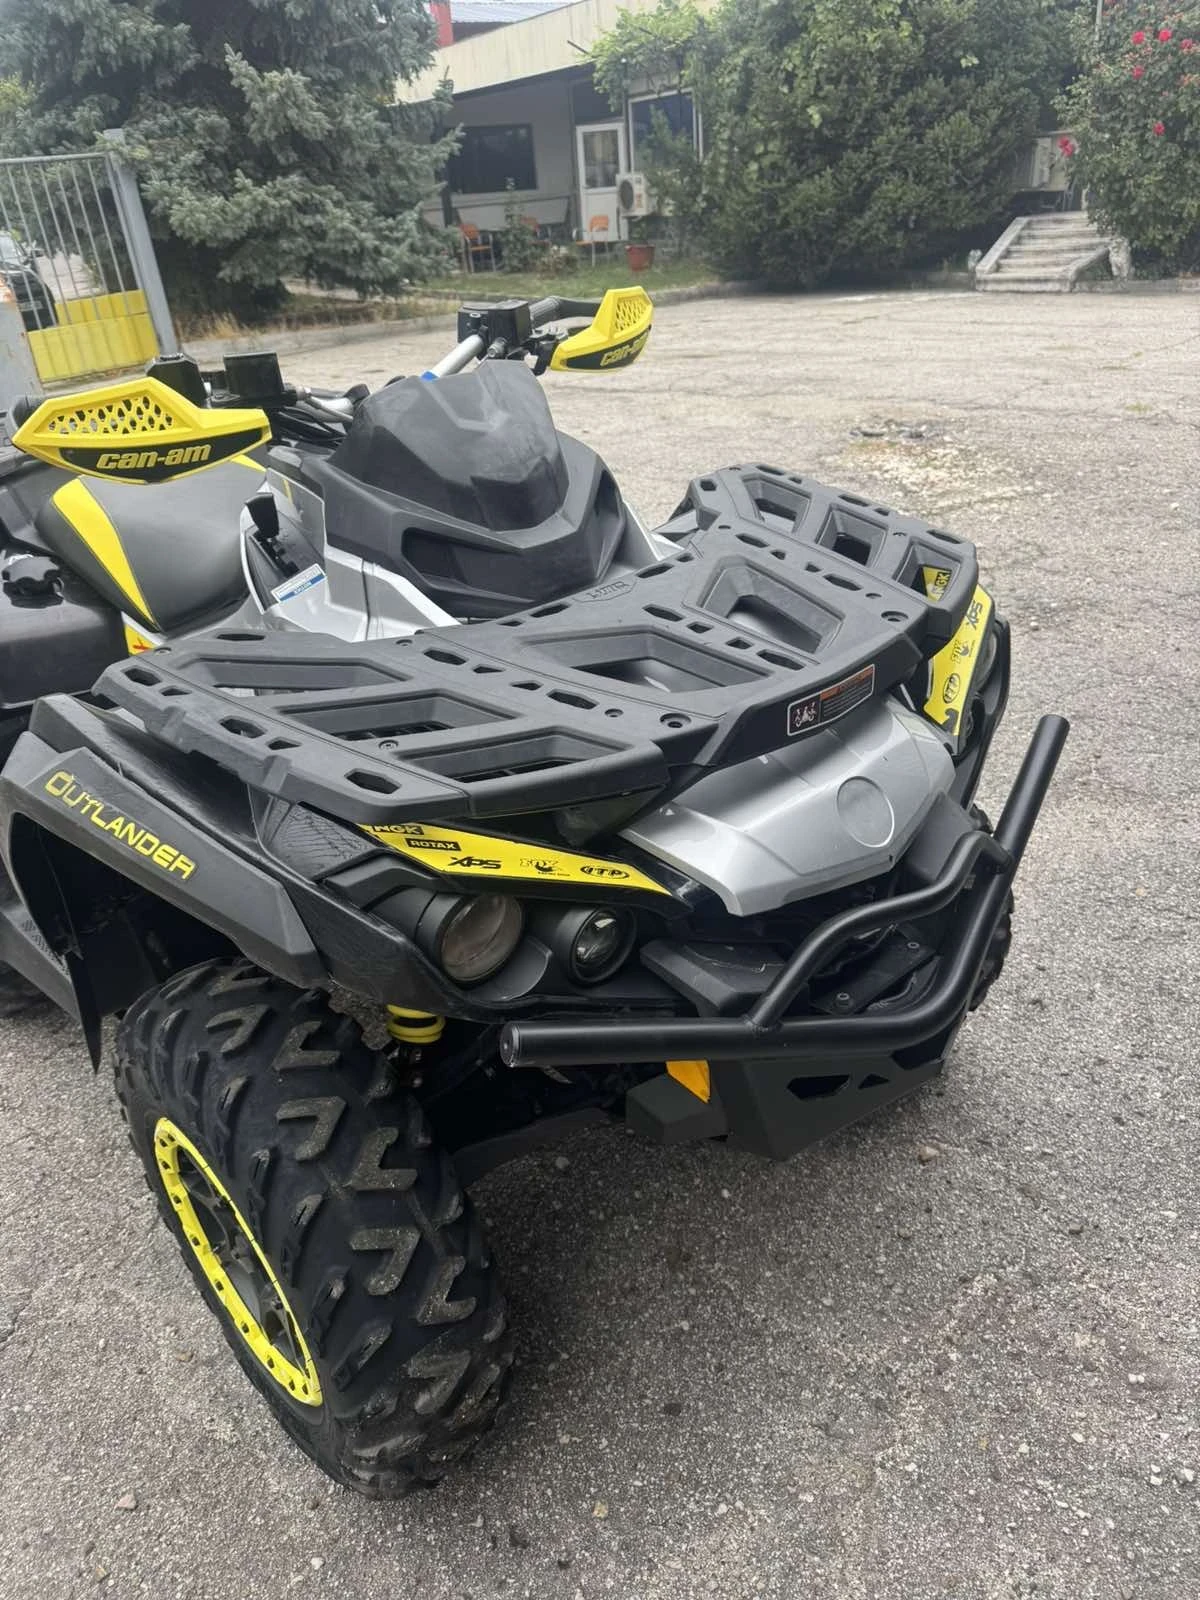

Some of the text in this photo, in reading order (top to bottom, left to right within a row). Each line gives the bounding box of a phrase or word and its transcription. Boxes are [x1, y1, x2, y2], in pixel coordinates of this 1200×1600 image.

[96, 444, 212, 469] can-am
[45, 771, 197, 879] OUTLANDER
[372, 825, 422, 835] NGK
[410, 839, 457, 851] ROTAX
[447, 856, 502, 870] XPS
